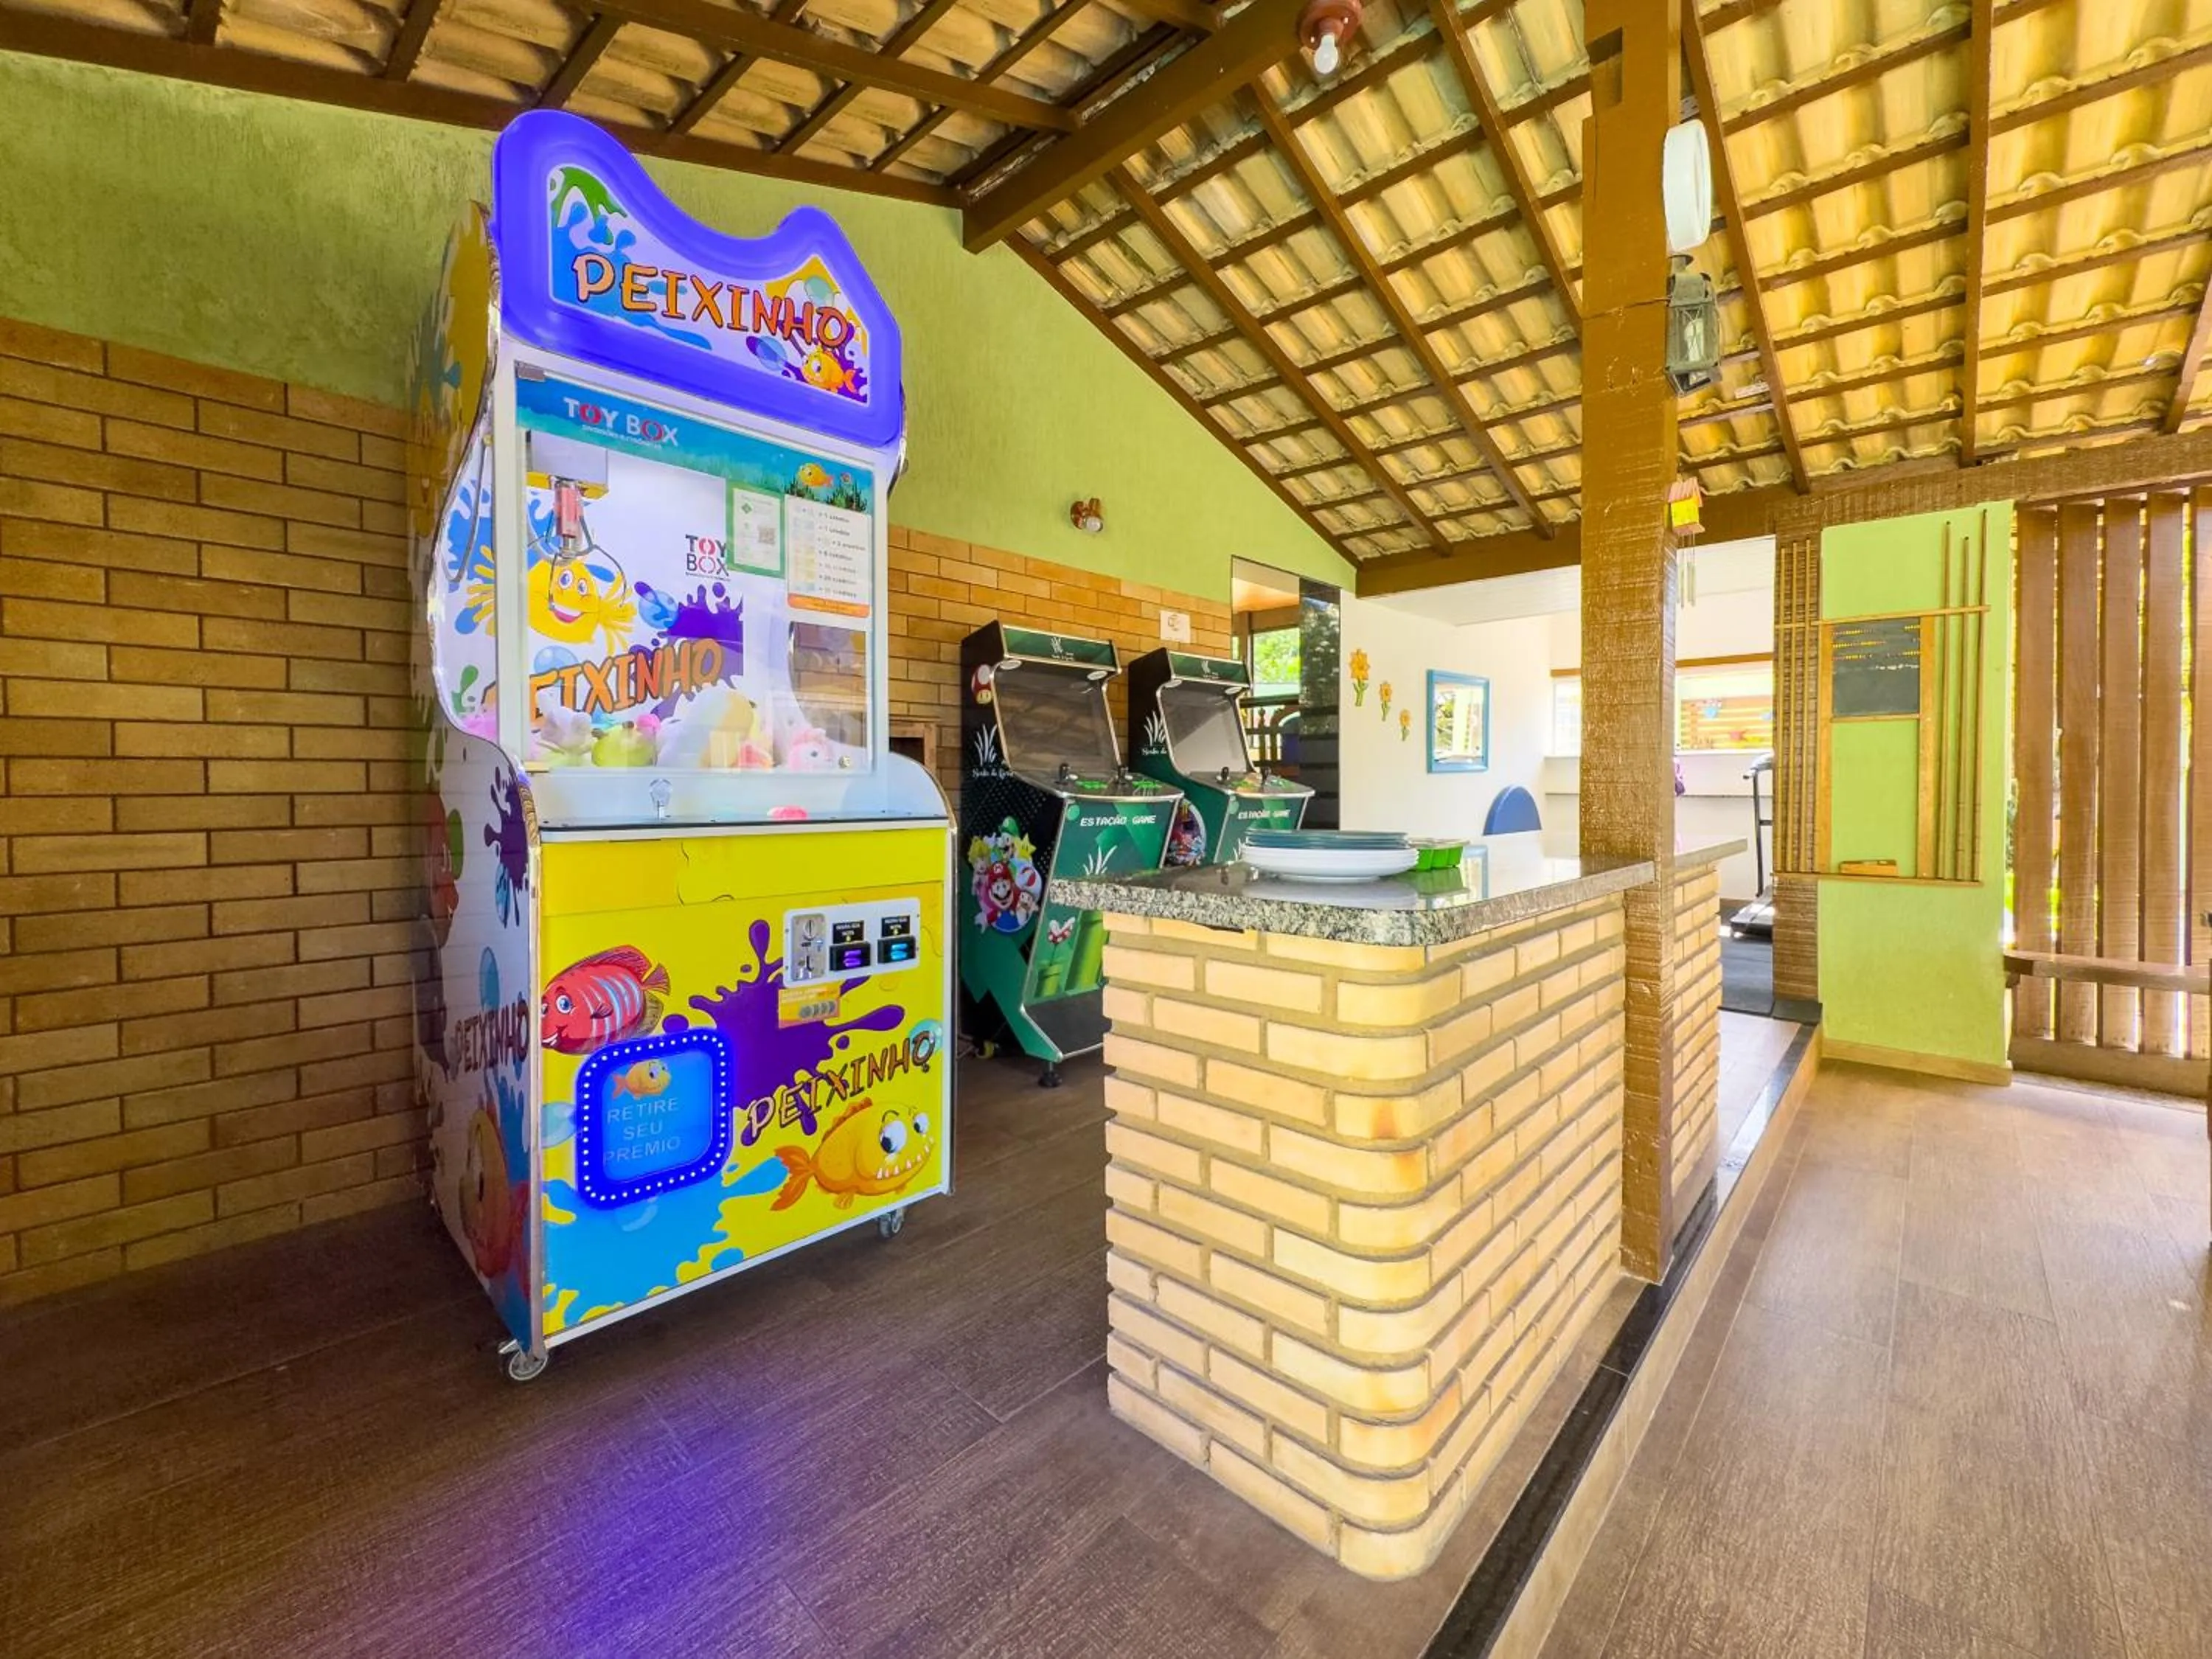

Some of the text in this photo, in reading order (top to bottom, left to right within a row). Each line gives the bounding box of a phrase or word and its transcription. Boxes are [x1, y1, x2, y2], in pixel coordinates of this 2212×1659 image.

[572, 251, 849, 349] PEIXINHO
[563, 397, 619, 428] TOY
[627, 414, 679, 447] BOX
[685, 534, 726, 557] TOY
[686, 552, 729, 577] BOX
[1132, 815, 1157, 825] GAME
[747, 1030, 936, 1138] PEIXINHO
[607, 1097, 679, 1125] RETIRE
[622, 1119, 663, 1141] SEU
[602, 1135, 681, 1167] PREMIO
